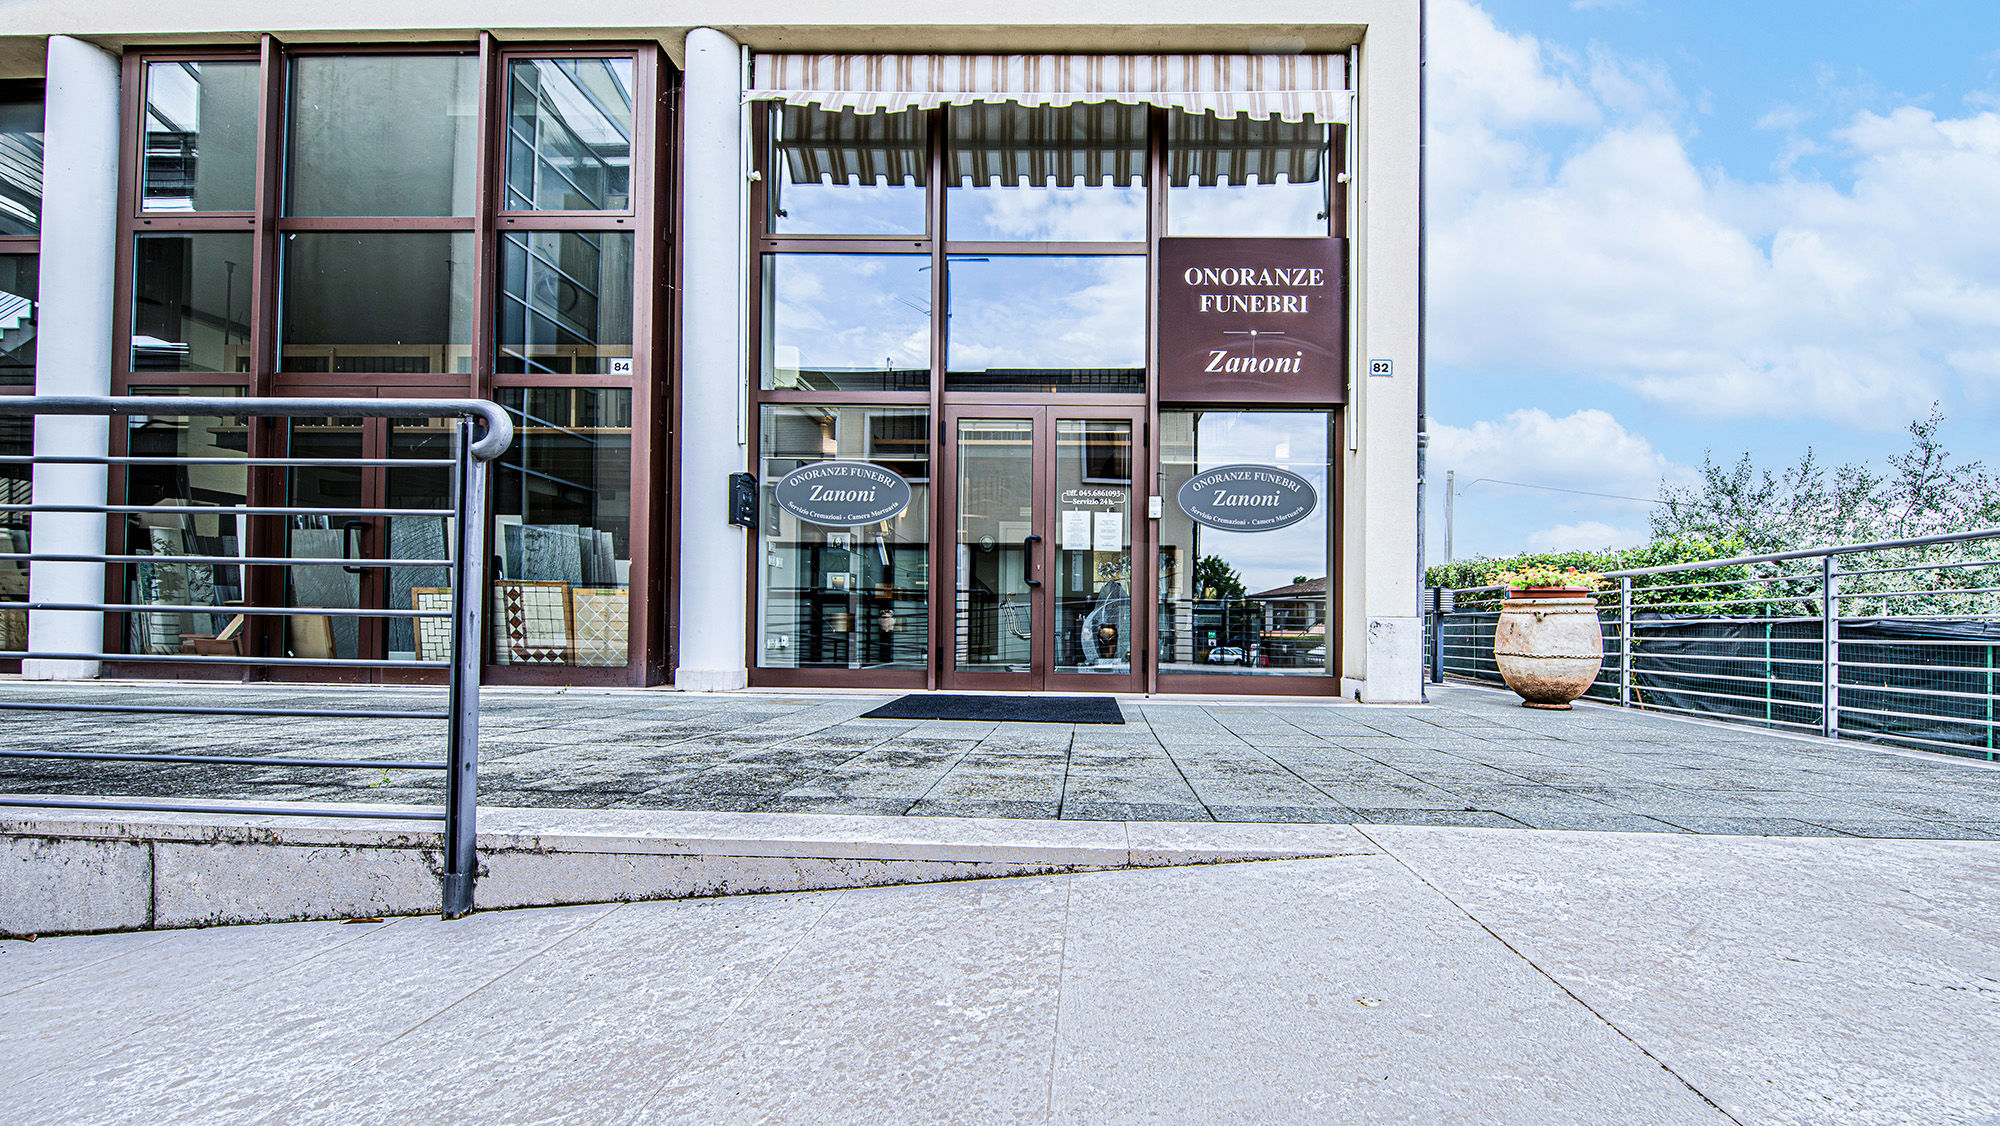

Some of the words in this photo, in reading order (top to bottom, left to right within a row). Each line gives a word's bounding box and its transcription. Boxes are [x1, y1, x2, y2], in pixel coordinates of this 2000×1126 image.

[1184, 267, 1325, 287] ONORANZE
[1199, 295, 1309, 313] FUNEBRI
[613, 362, 630, 372] 84
[1204, 350, 1303, 374] Zanoni
[1373, 362, 1389, 373] 82
[789, 467, 848, 487] ONORANZE
[850, 467, 897, 489] FUNEBRI
[1192, 472, 1252, 492] ONORANZE
[1254, 472, 1301, 493] FUNEBRI
[809, 485, 876, 502] Zanoni
[1212, 490, 1281, 507] Zanoni
[787, 501, 810, 516] Servizio
[809, 510, 842, 521] Cremazioni
[847, 512, 870, 521] Camera
[871, 501, 899, 517] Mortuaria
[1190, 505, 1213, 521] Servizio
[1213, 515, 1246, 526] Cremazioni
[1251, 517, 1275, 526] Camera
[1275, 506, 1304, 522] Mortuaria
